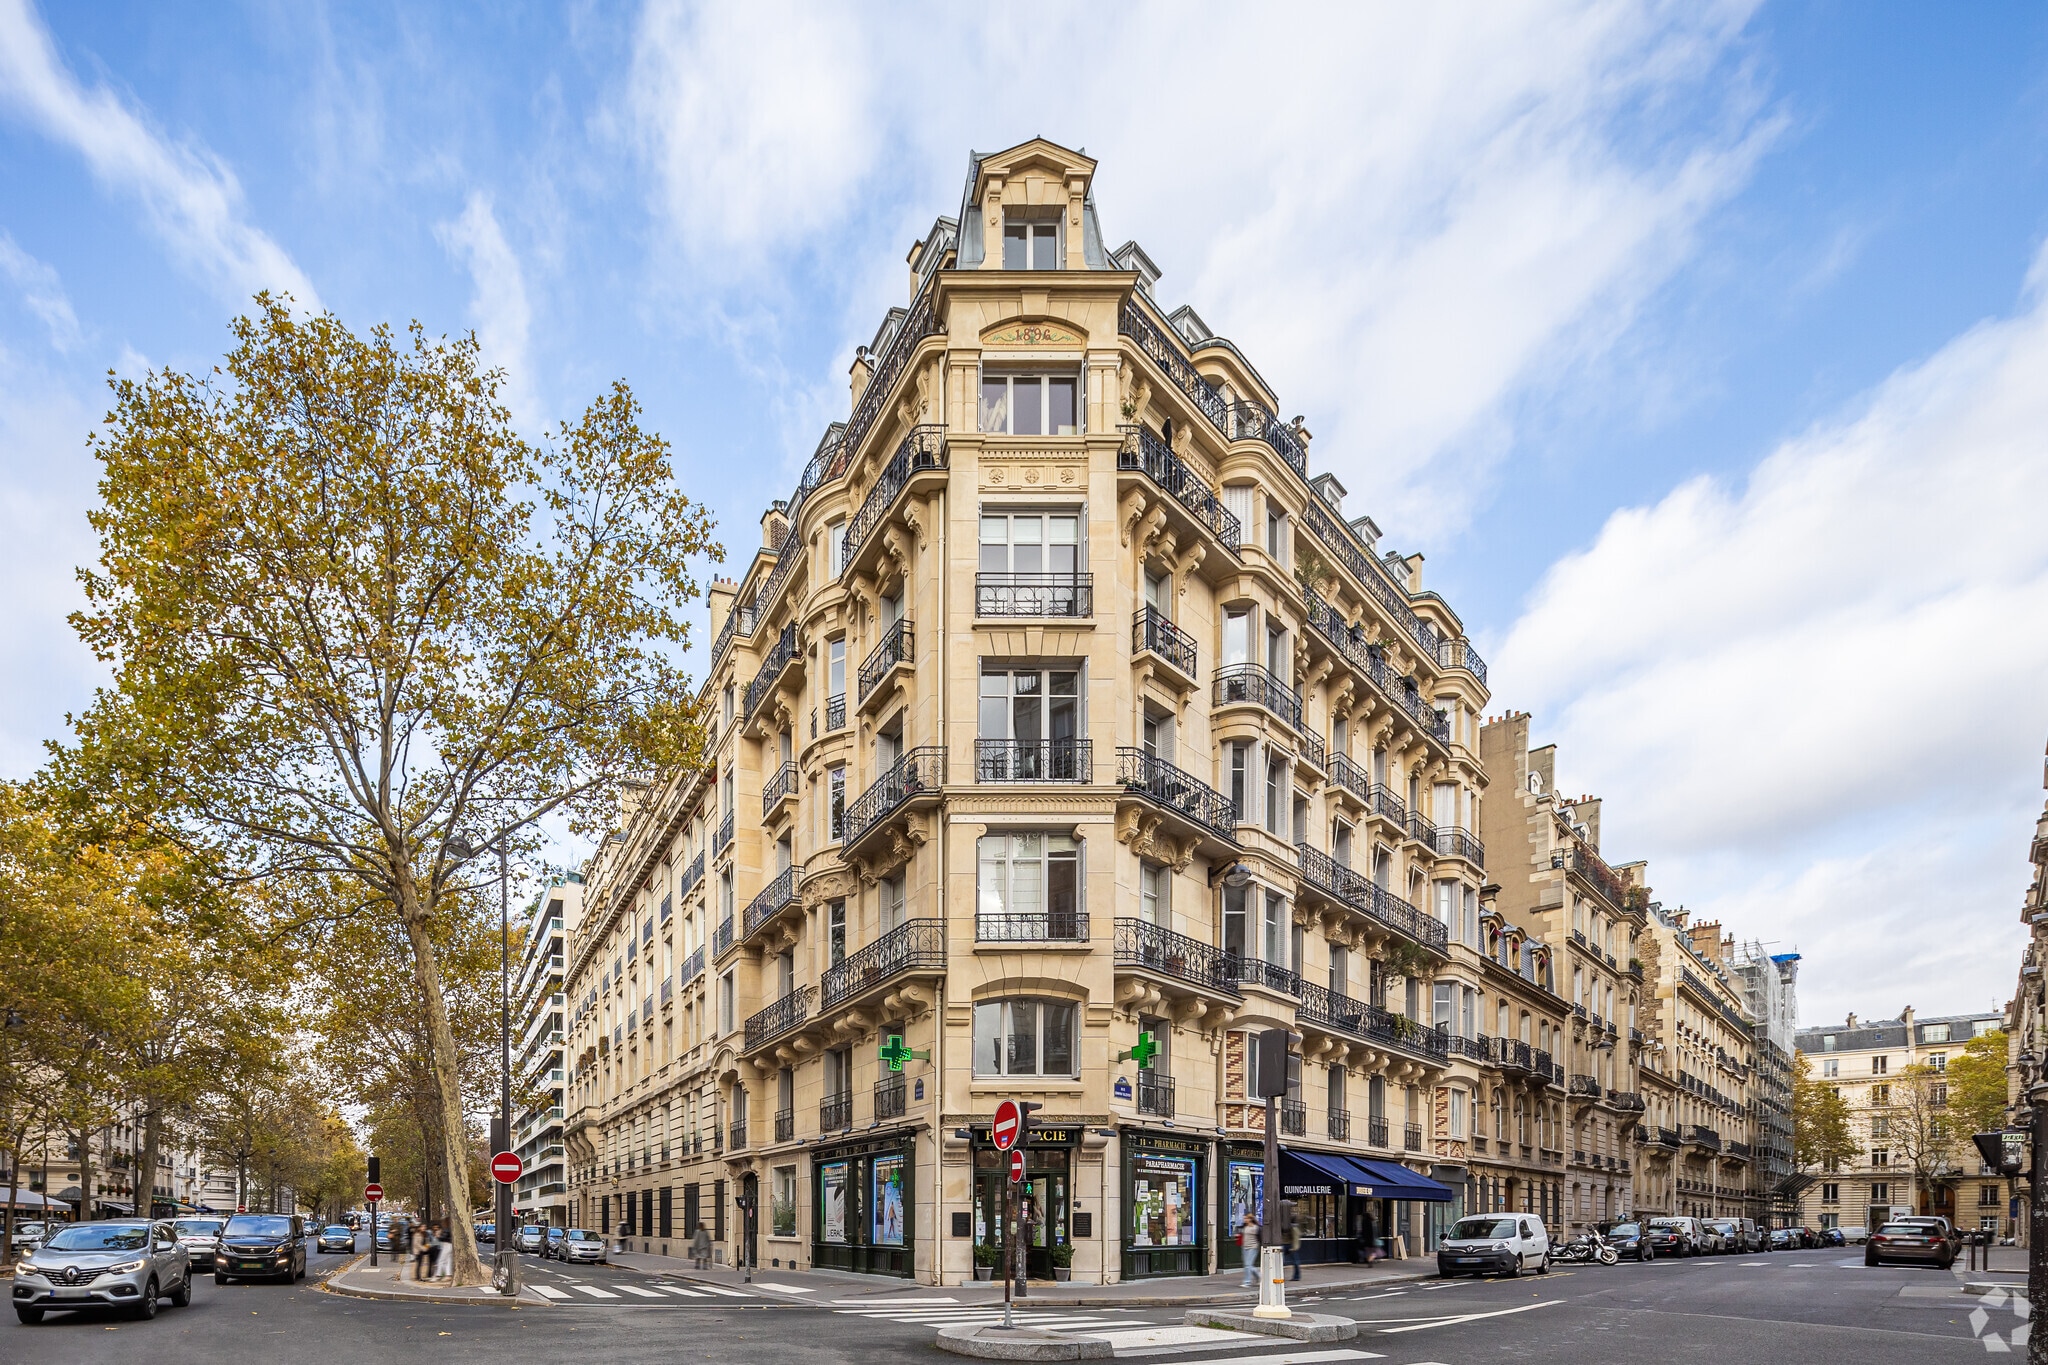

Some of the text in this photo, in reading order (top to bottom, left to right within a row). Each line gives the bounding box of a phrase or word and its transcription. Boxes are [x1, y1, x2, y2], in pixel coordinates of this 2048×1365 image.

[1016, 328, 1051, 341] 1896
[1154, 1139, 1187, 1150] PHARMACIE
[1145, 1160, 1185, 1170] PARAPHARMACIE
[1284, 1185, 1332, 1195] QUINCAILLERIE
